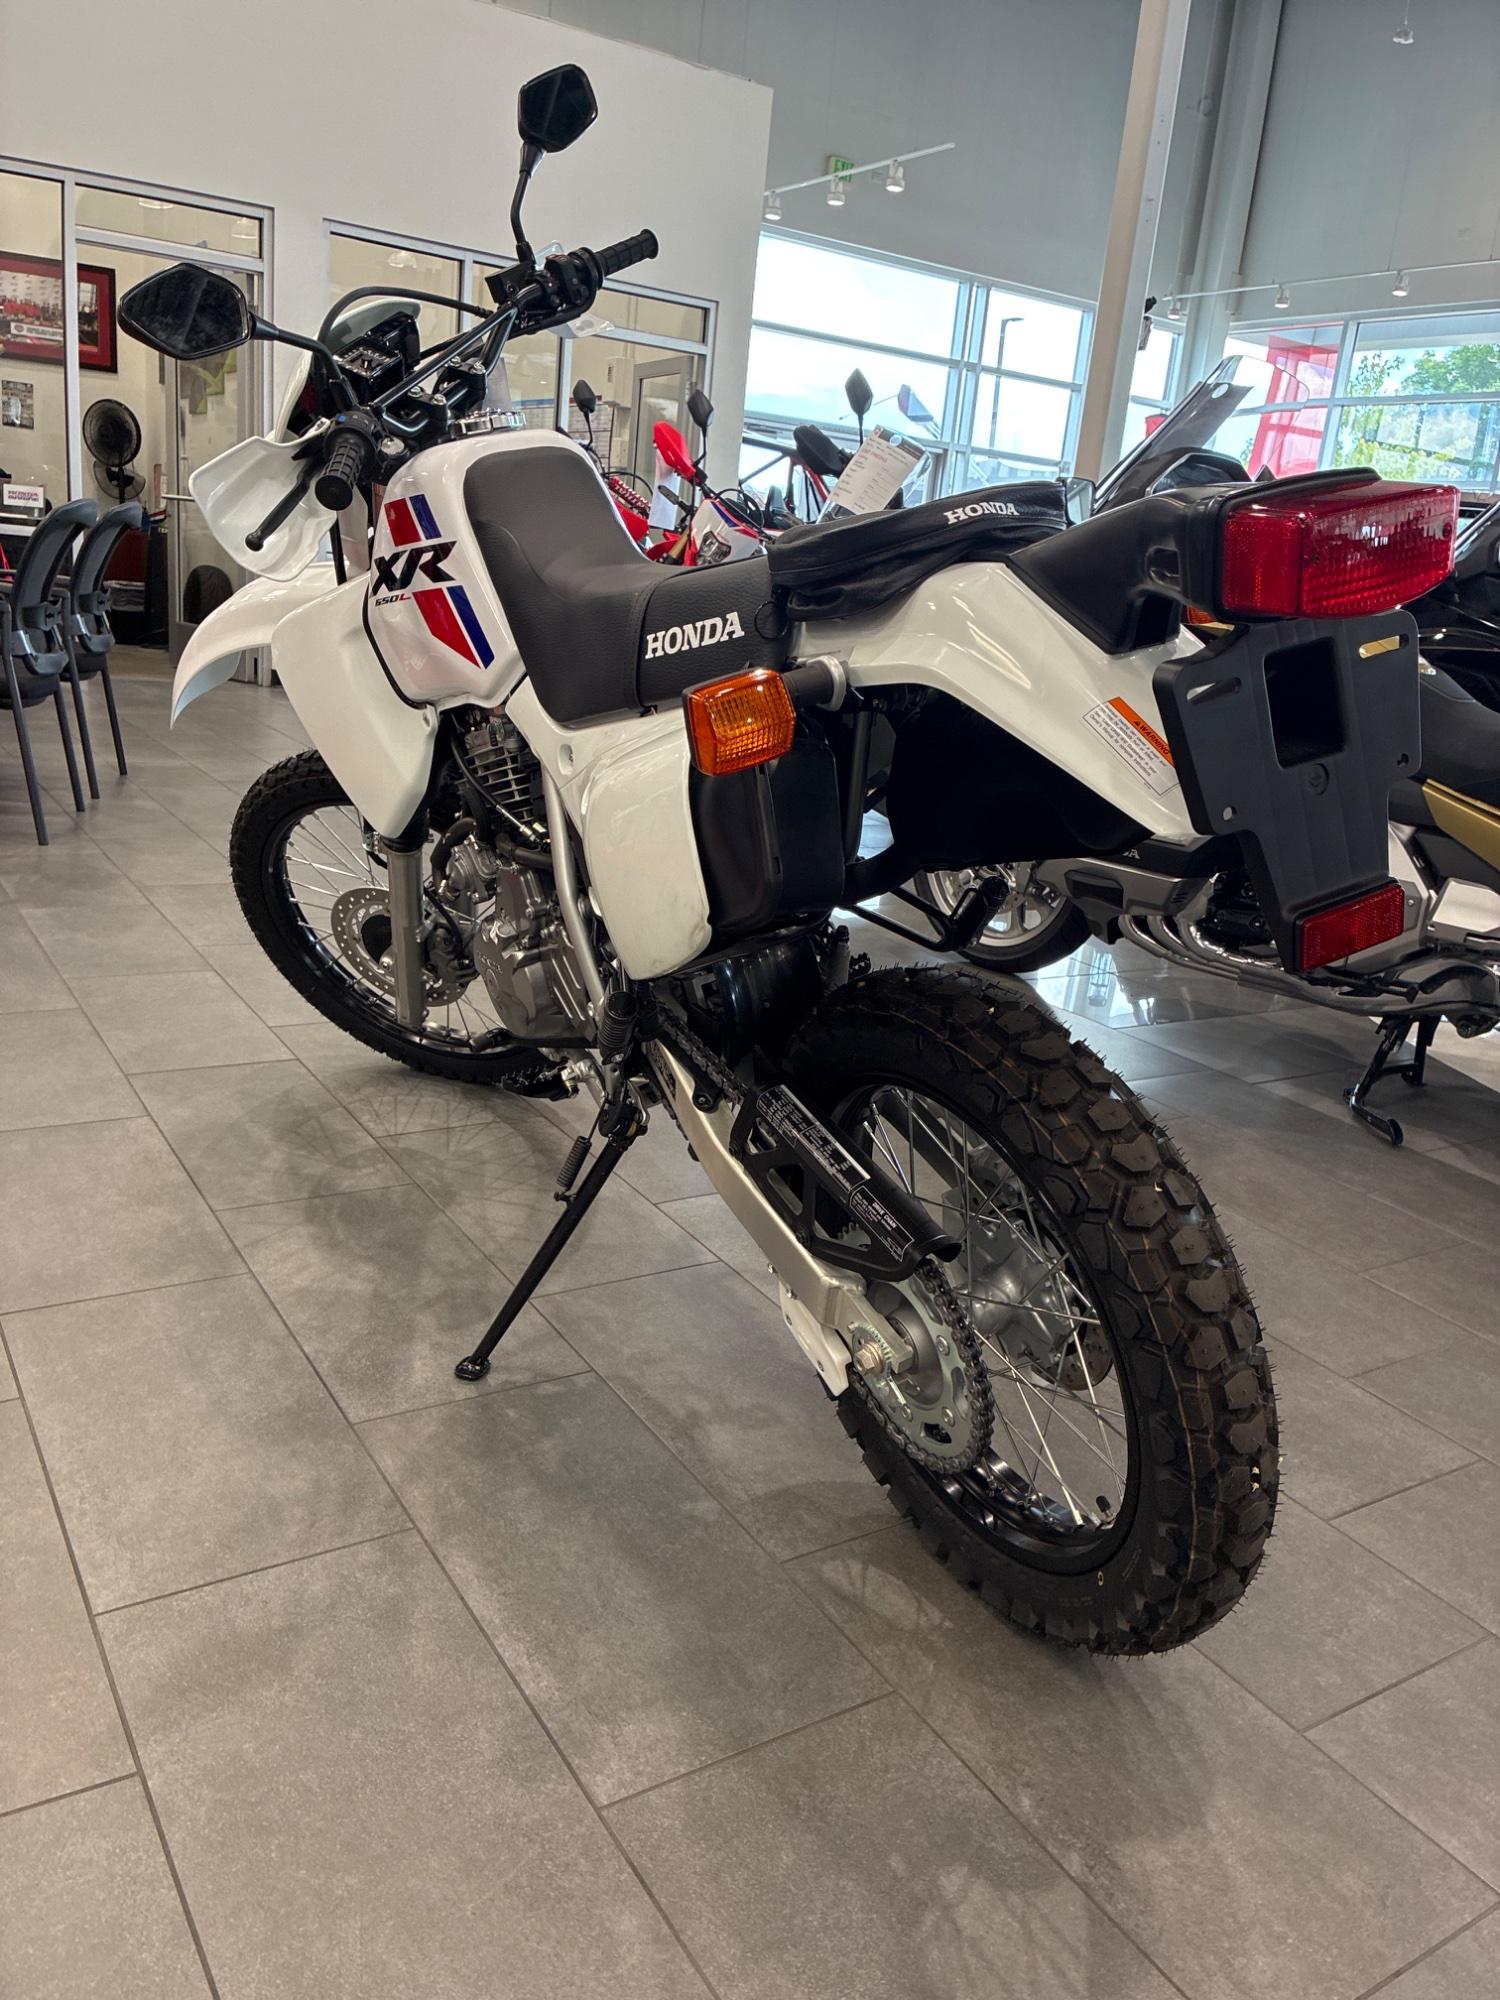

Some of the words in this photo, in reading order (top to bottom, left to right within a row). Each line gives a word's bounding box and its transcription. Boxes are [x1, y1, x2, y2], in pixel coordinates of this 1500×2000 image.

[943, 501, 1020, 525] HONDA
[371, 540, 457, 596] XR
[375, 593, 412, 607] 650L
[645, 611, 745, 659] HONDA
[1139, 724, 1170, 754] WARNING
[871, 1201, 885, 1215] DRIVE
[882, 1214, 897, 1228] CHAIN
